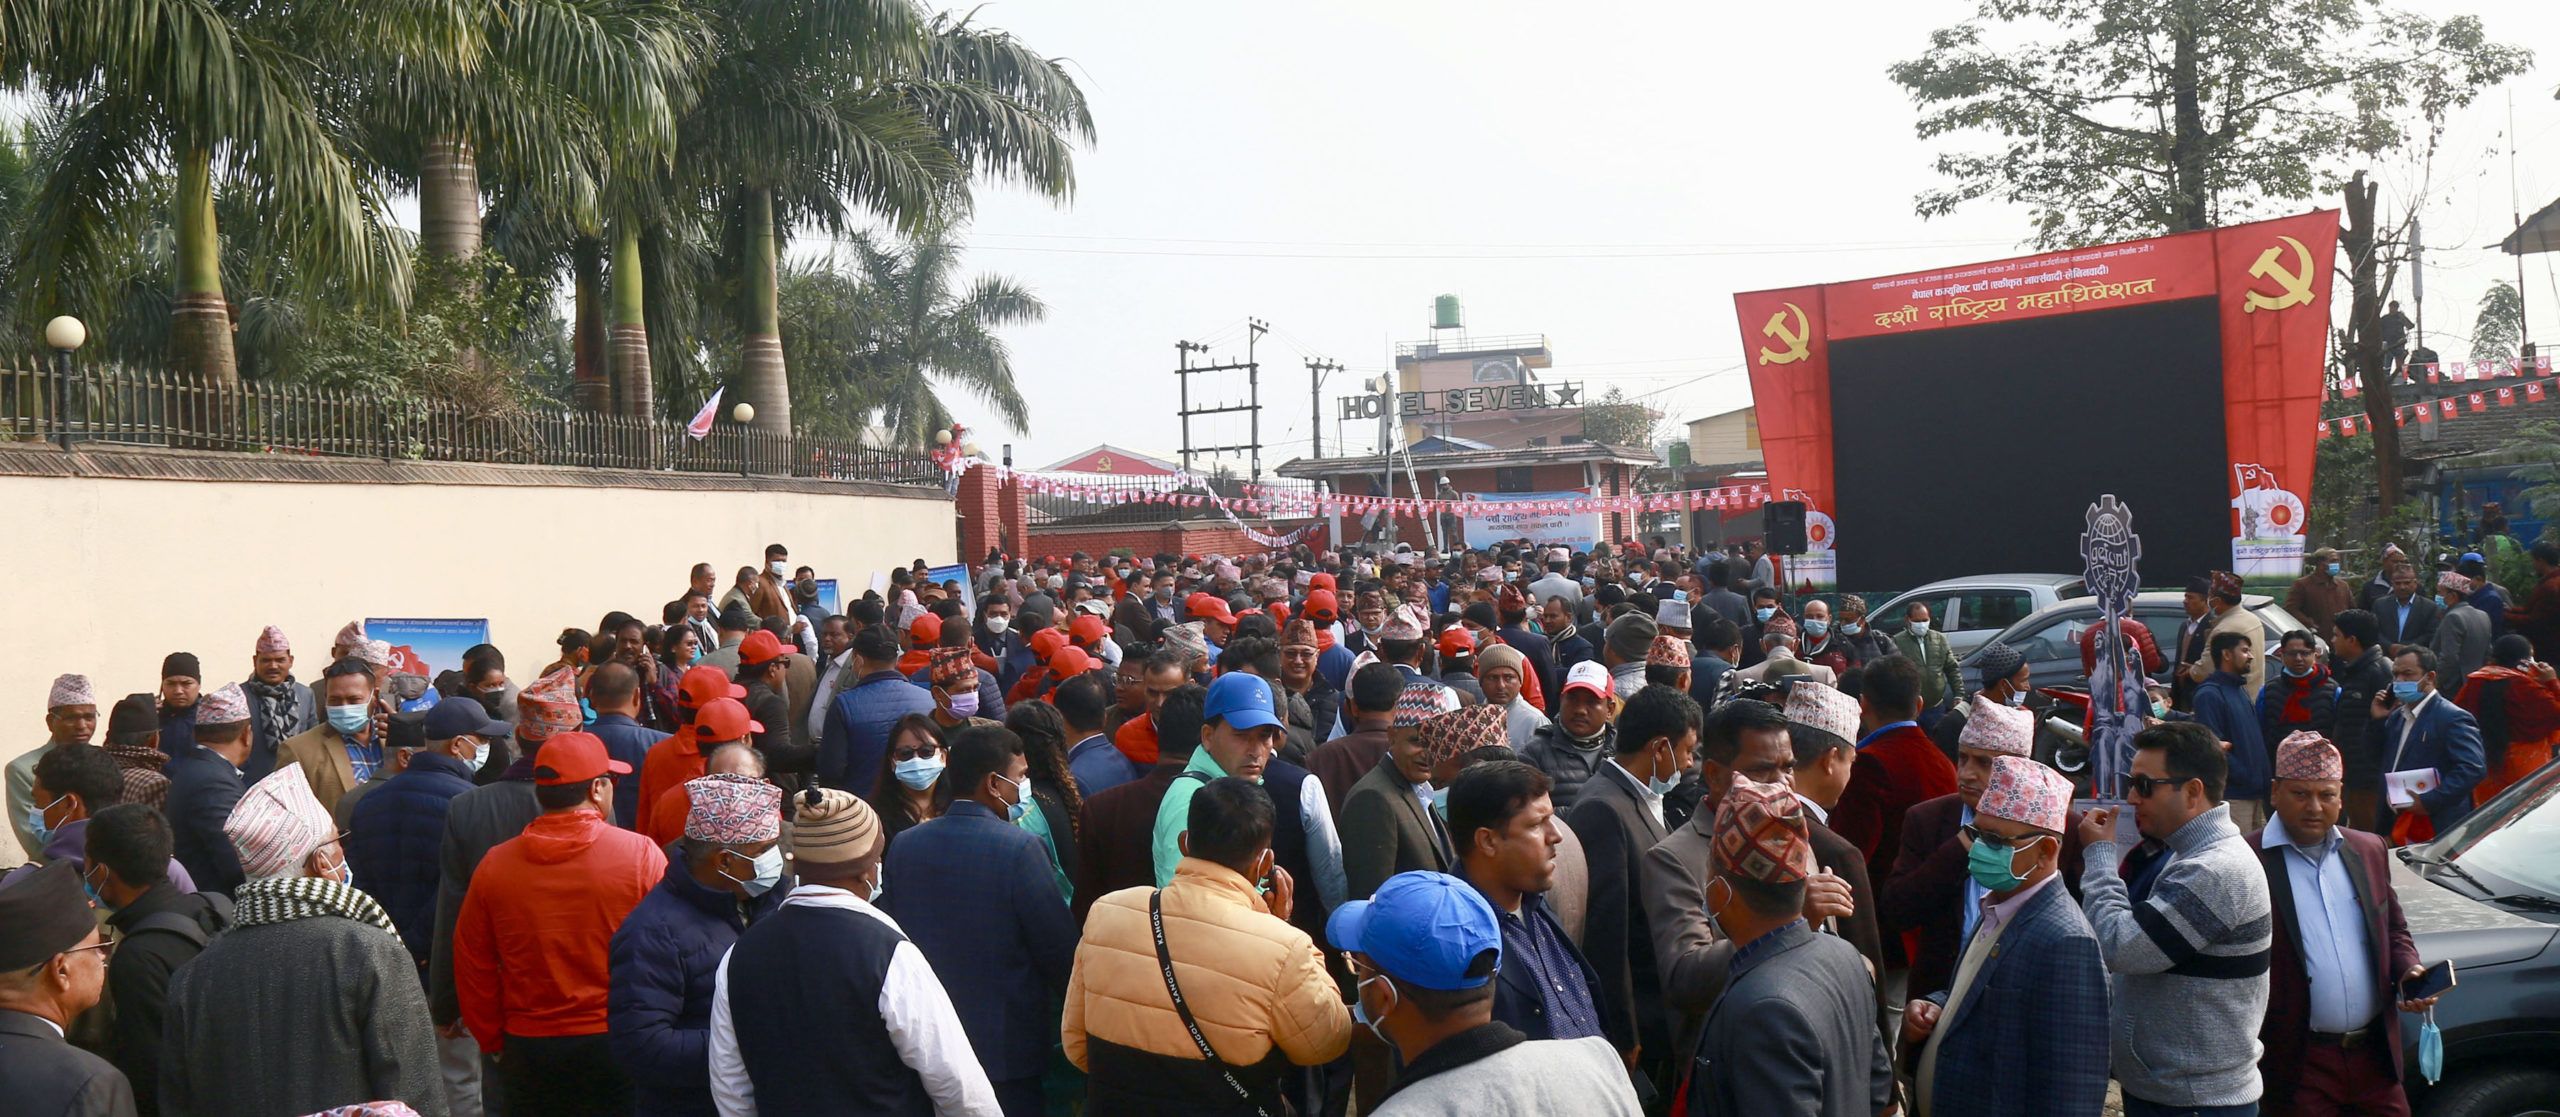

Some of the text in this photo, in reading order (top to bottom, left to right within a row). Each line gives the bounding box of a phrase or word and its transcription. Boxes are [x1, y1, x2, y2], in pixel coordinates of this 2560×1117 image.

[1912, 289, 1933, 300] नेपाल
[1928, 296, 2008, 320] राष्ट्रिय
[2016, 278, 2156, 310] महाधिवेशन
[1343, 384, 1546, 420] HOEL SEVEN
[1152, 908, 1164, 945] KANGOL
[1164, 964, 1182, 1004] KANGOL
[1188, 1021, 1214, 1058] KANGOL
[1223, 1070, 1249, 1099] KANGOL
